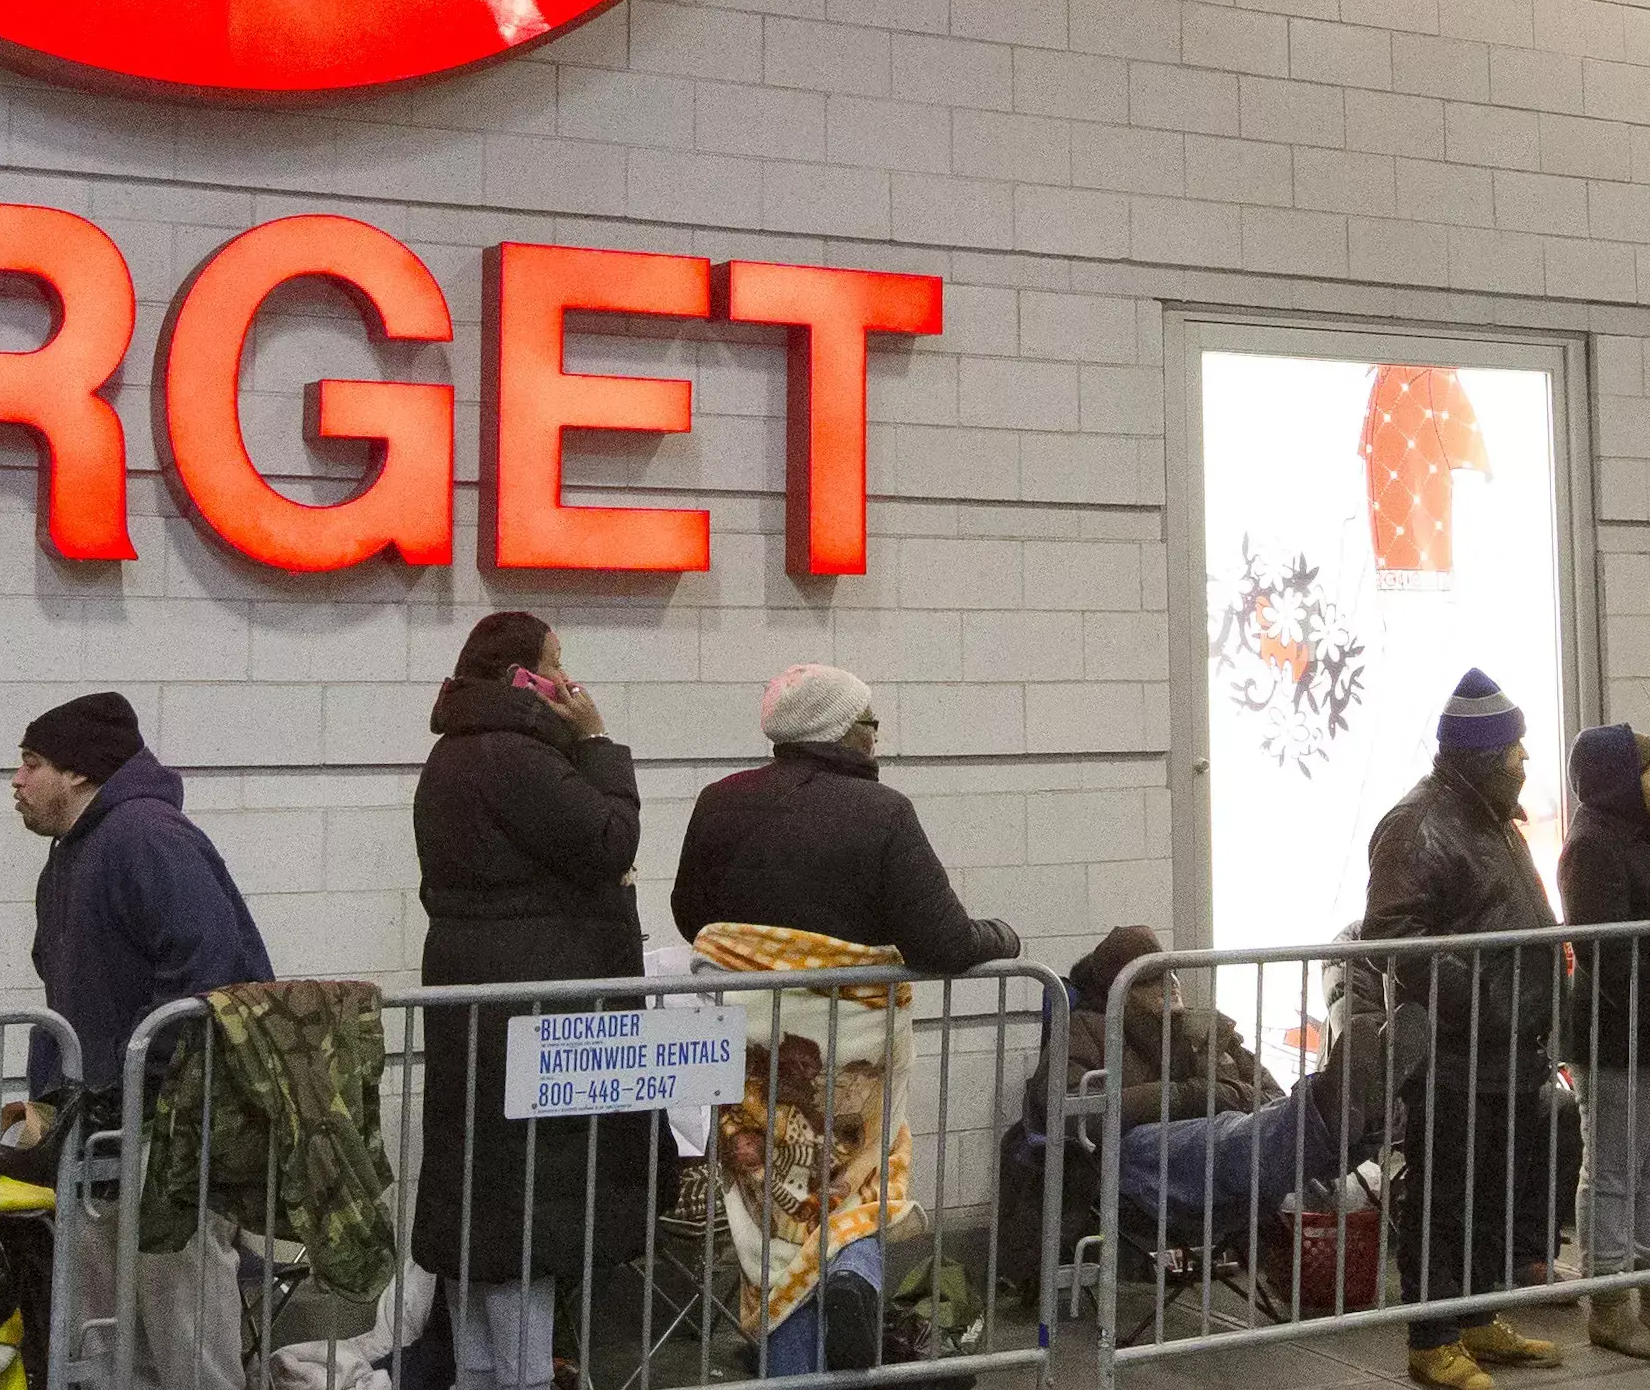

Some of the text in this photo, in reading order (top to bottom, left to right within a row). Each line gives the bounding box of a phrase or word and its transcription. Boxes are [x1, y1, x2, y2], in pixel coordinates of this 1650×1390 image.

[540, 1013, 640, 1041] BLOCKADER
[539, 1039, 730, 1074] NATIONWIDE RENTALS
[538, 1075, 677, 1107] 800-448-2647
